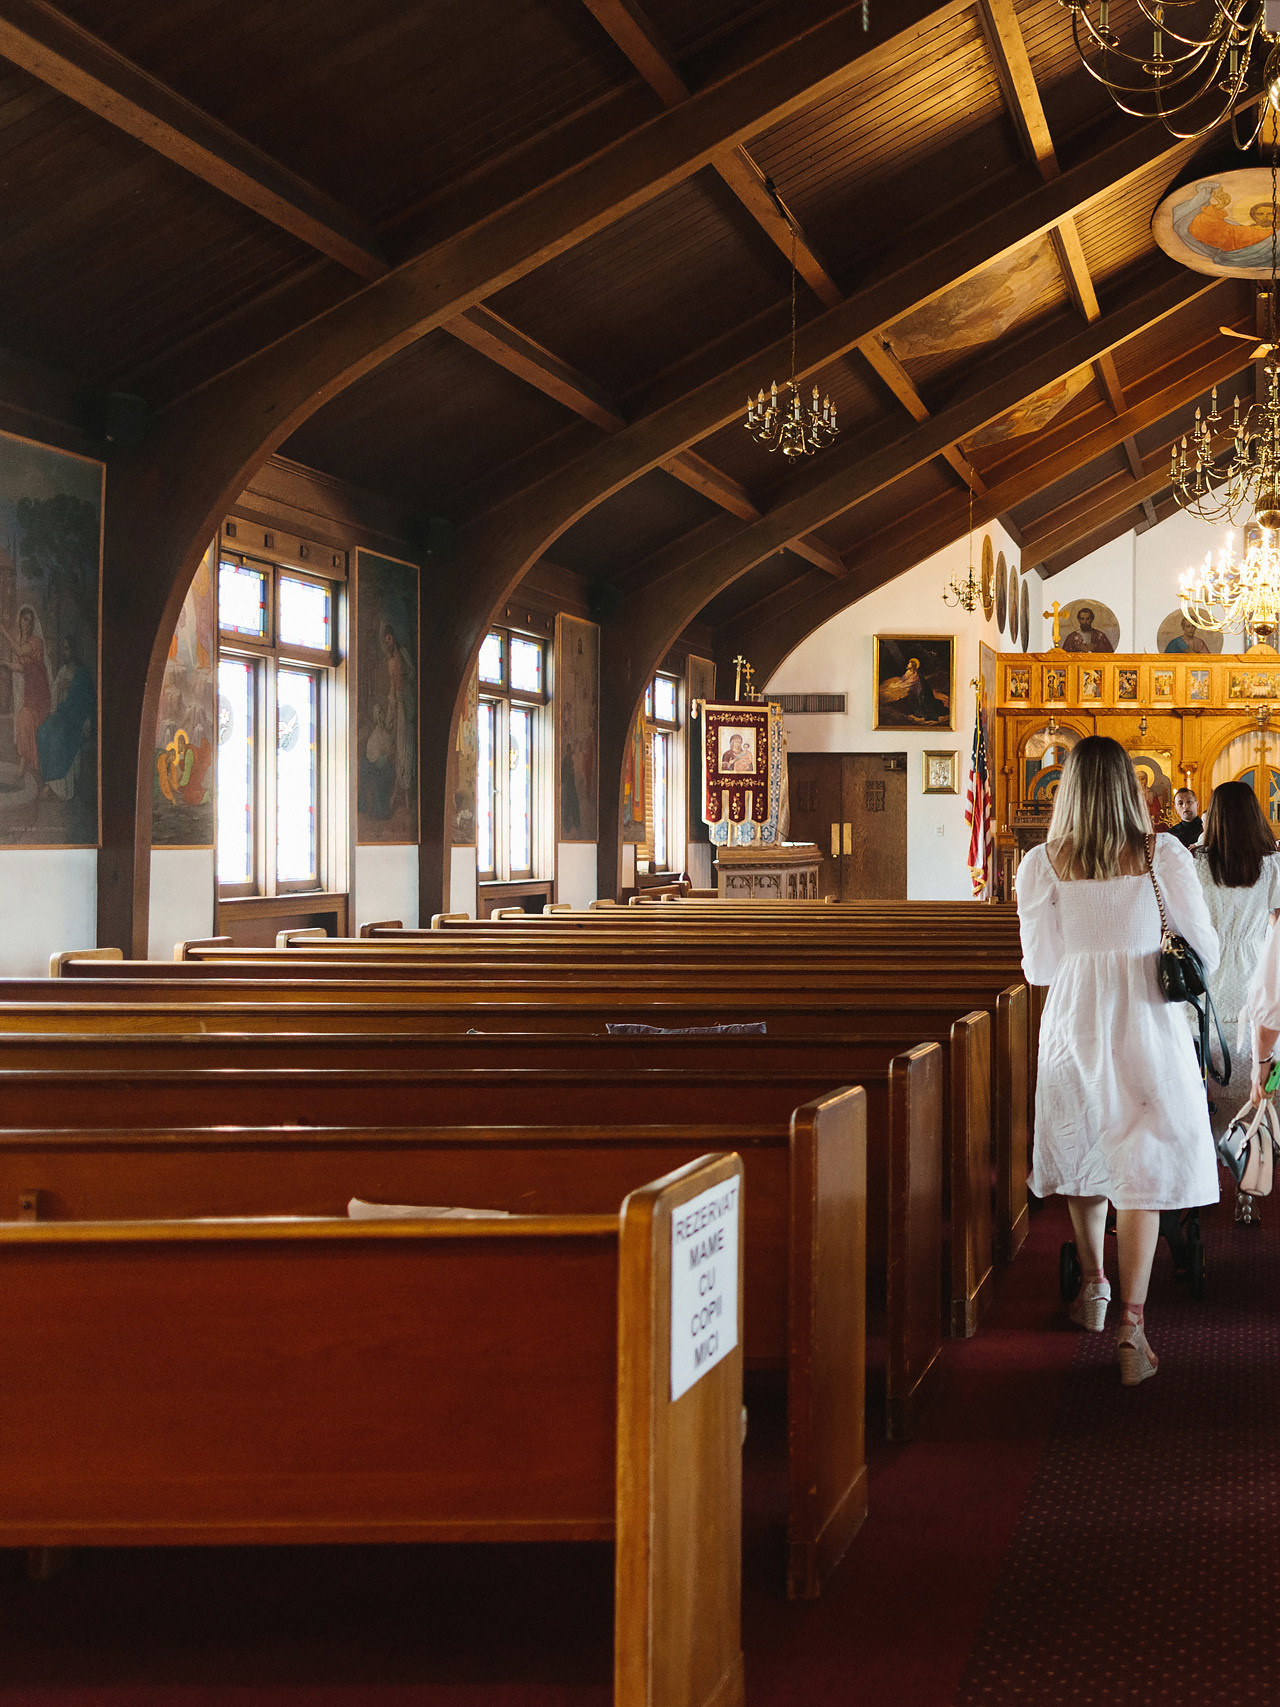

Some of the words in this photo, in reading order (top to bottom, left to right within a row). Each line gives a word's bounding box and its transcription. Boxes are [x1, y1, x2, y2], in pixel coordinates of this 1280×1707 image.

[676, 1189, 737, 1240] REZERVAT
[690, 1228, 724, 1269] MAME
[699, 1267, 716, 1297] CU
[694, 1331, 718, 1368] MICI
